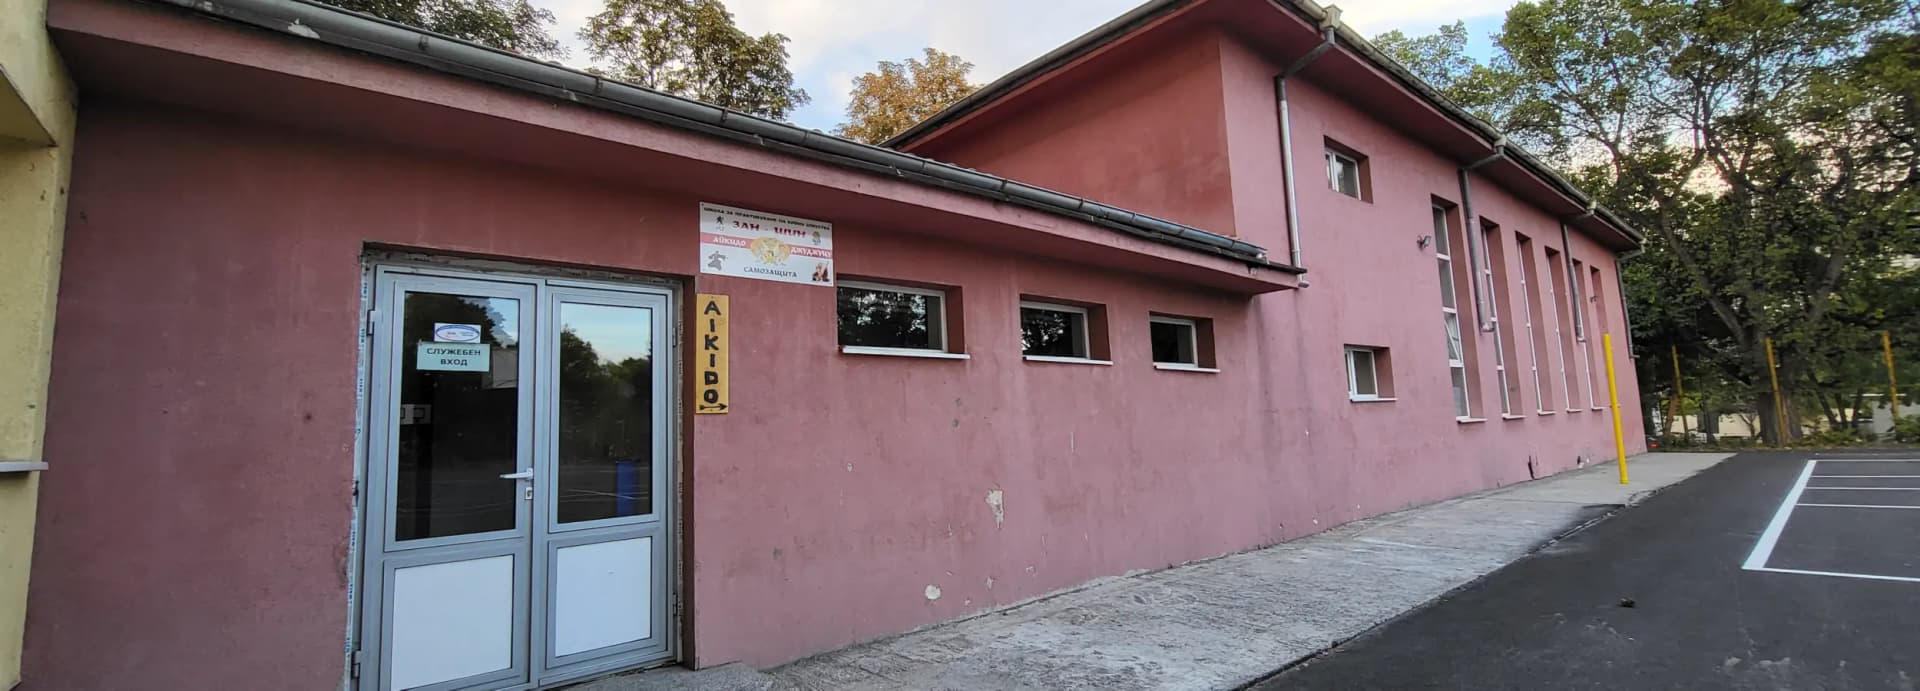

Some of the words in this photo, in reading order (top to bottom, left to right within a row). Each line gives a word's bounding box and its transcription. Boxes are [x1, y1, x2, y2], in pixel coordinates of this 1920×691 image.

[732, 220, 760, 231] ЗАН
[713, 236, 746, 246] АЙКИДО
[743, 266, 798, 278] САМОЗАЩИТА
[426, 348, 481, 356] СЛУЖЕБЕН
[704, 300, 721, 404] AIKIDO
